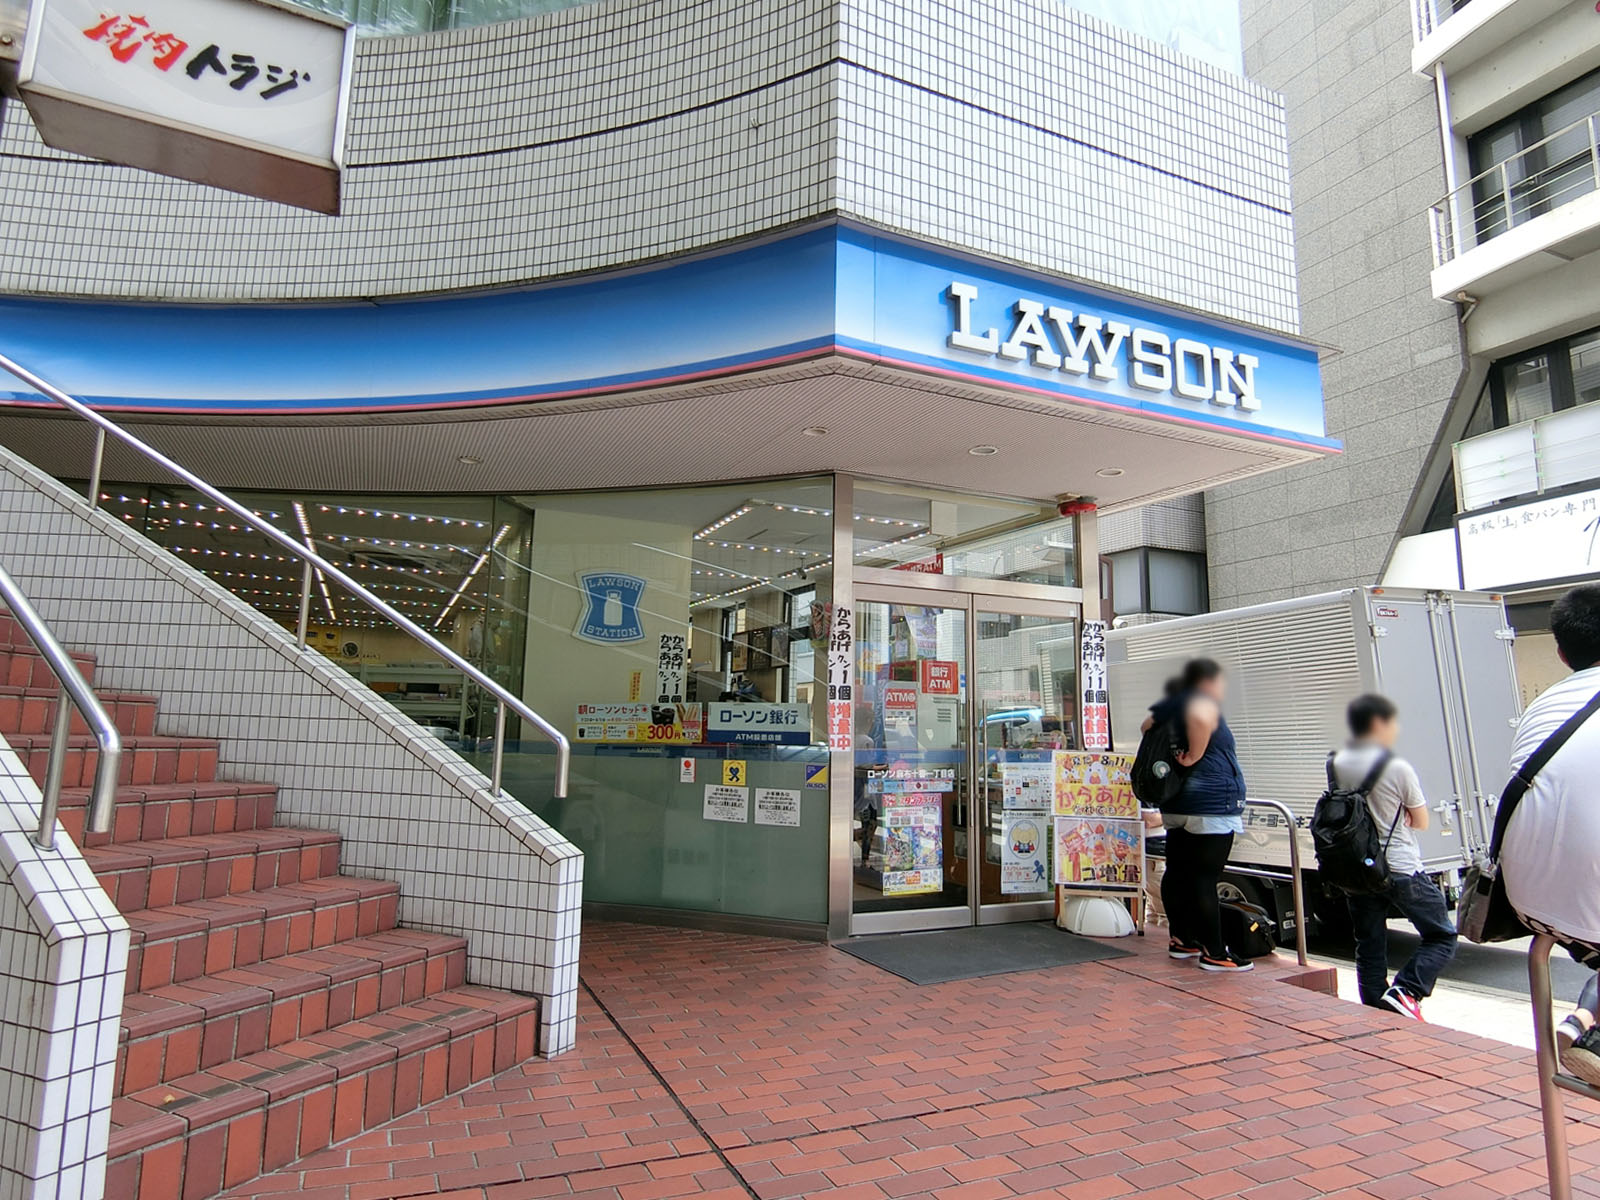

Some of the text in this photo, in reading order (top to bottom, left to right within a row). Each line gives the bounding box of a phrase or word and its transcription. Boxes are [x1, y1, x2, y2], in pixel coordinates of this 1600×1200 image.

[946, 281, 1262, 412] LAWSON
[588, 577, 640, 591] LAWSON
[586, 624, 637, 637] STATION
[930, 666, 949, 678] 銀行
[929, 679, 951, 689] ATM
[720, 709, 799, 725] ローソン銀行
